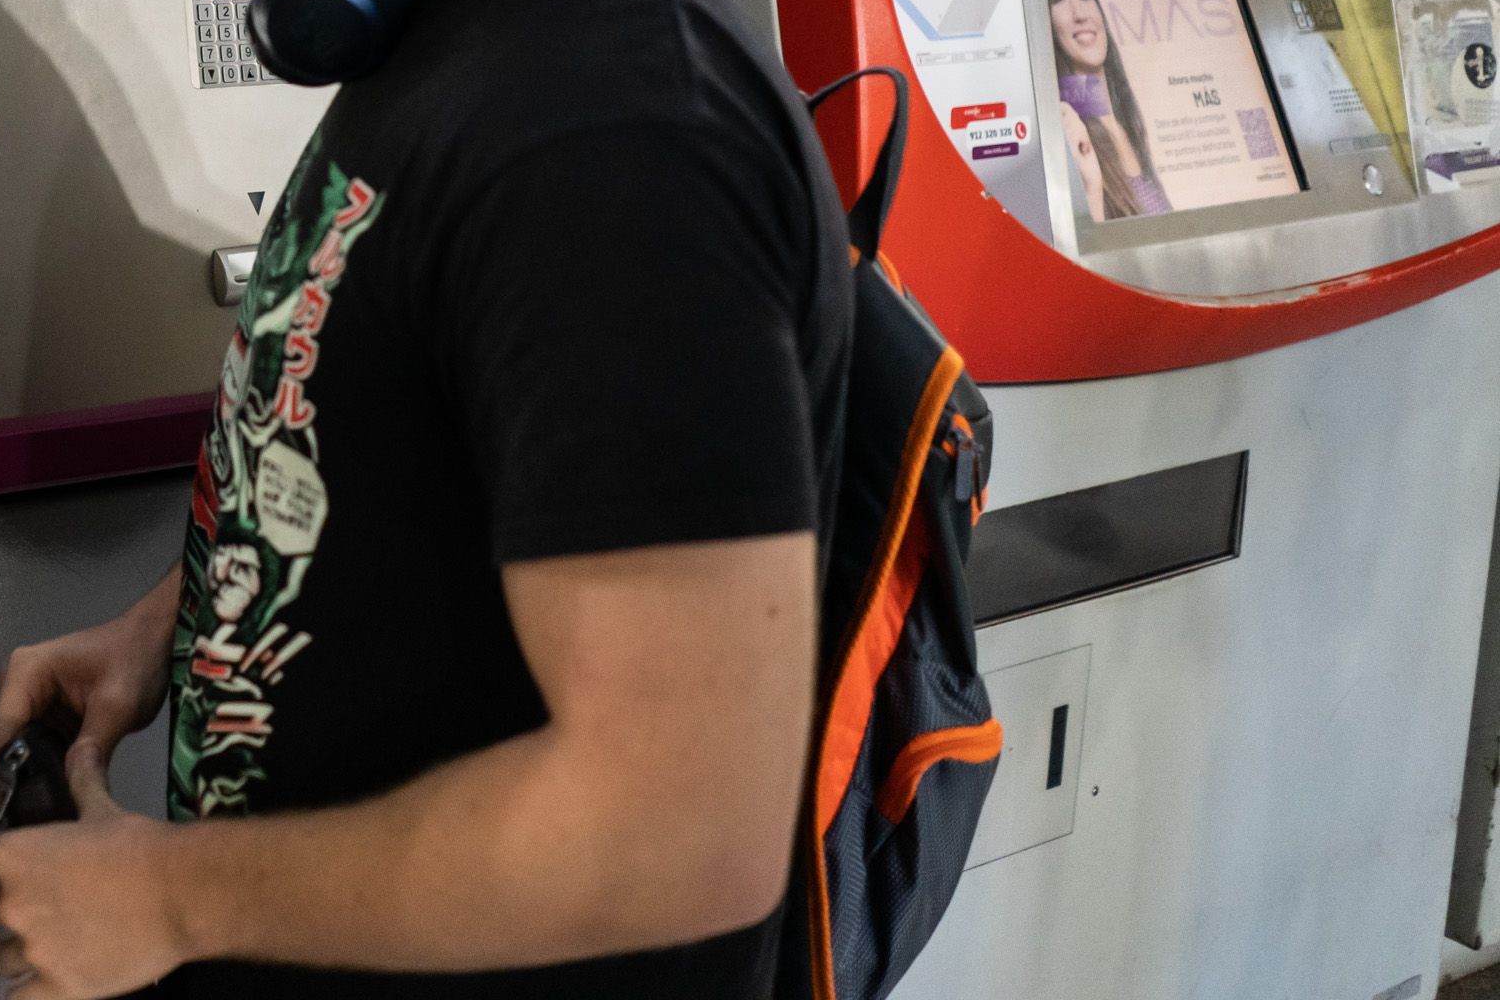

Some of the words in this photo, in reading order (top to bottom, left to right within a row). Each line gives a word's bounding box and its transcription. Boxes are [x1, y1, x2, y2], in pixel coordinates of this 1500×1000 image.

[1192, 85, 1221, 108] MÁS
[274, 177, 376, 429] フルカウル
